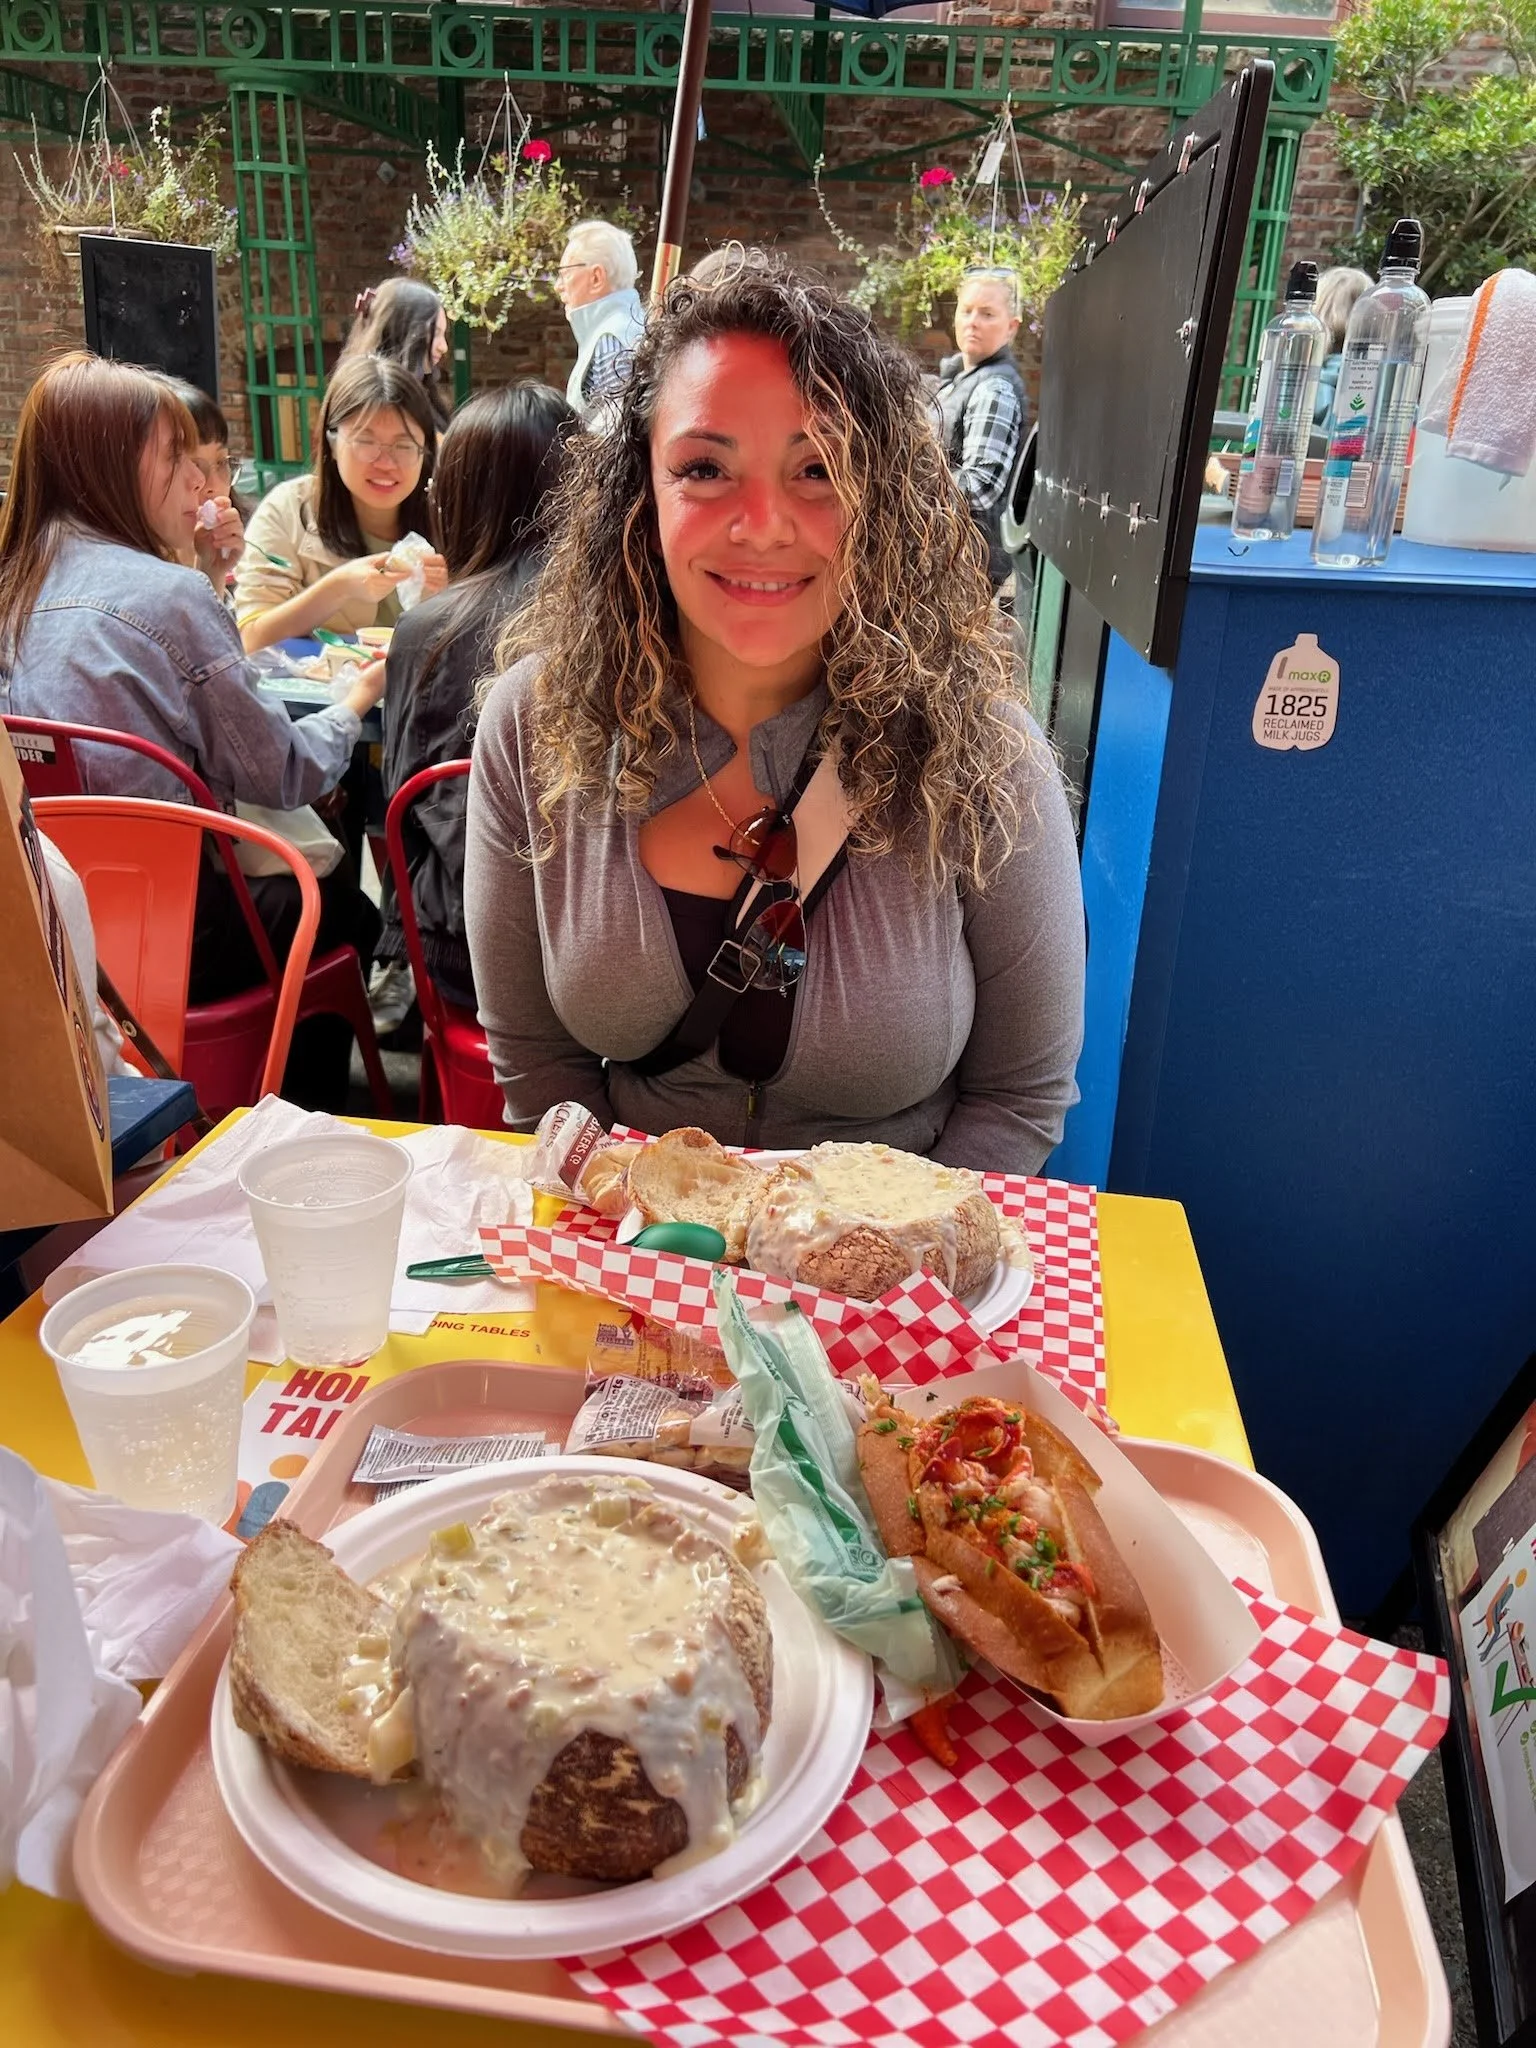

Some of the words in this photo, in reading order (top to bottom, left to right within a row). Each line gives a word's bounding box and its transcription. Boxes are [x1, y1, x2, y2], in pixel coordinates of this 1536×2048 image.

[1264, 694, 1328, 718] 1825
[1263, 718, 1324, 731] RECLAIMED
[1263, 730, 1289, 740] MILK
[1291, 731, 1321, 741] JUGS
[576, 1116, 600, 1154] BAKERS
[470, 1324, 531, 1337] TABLES
